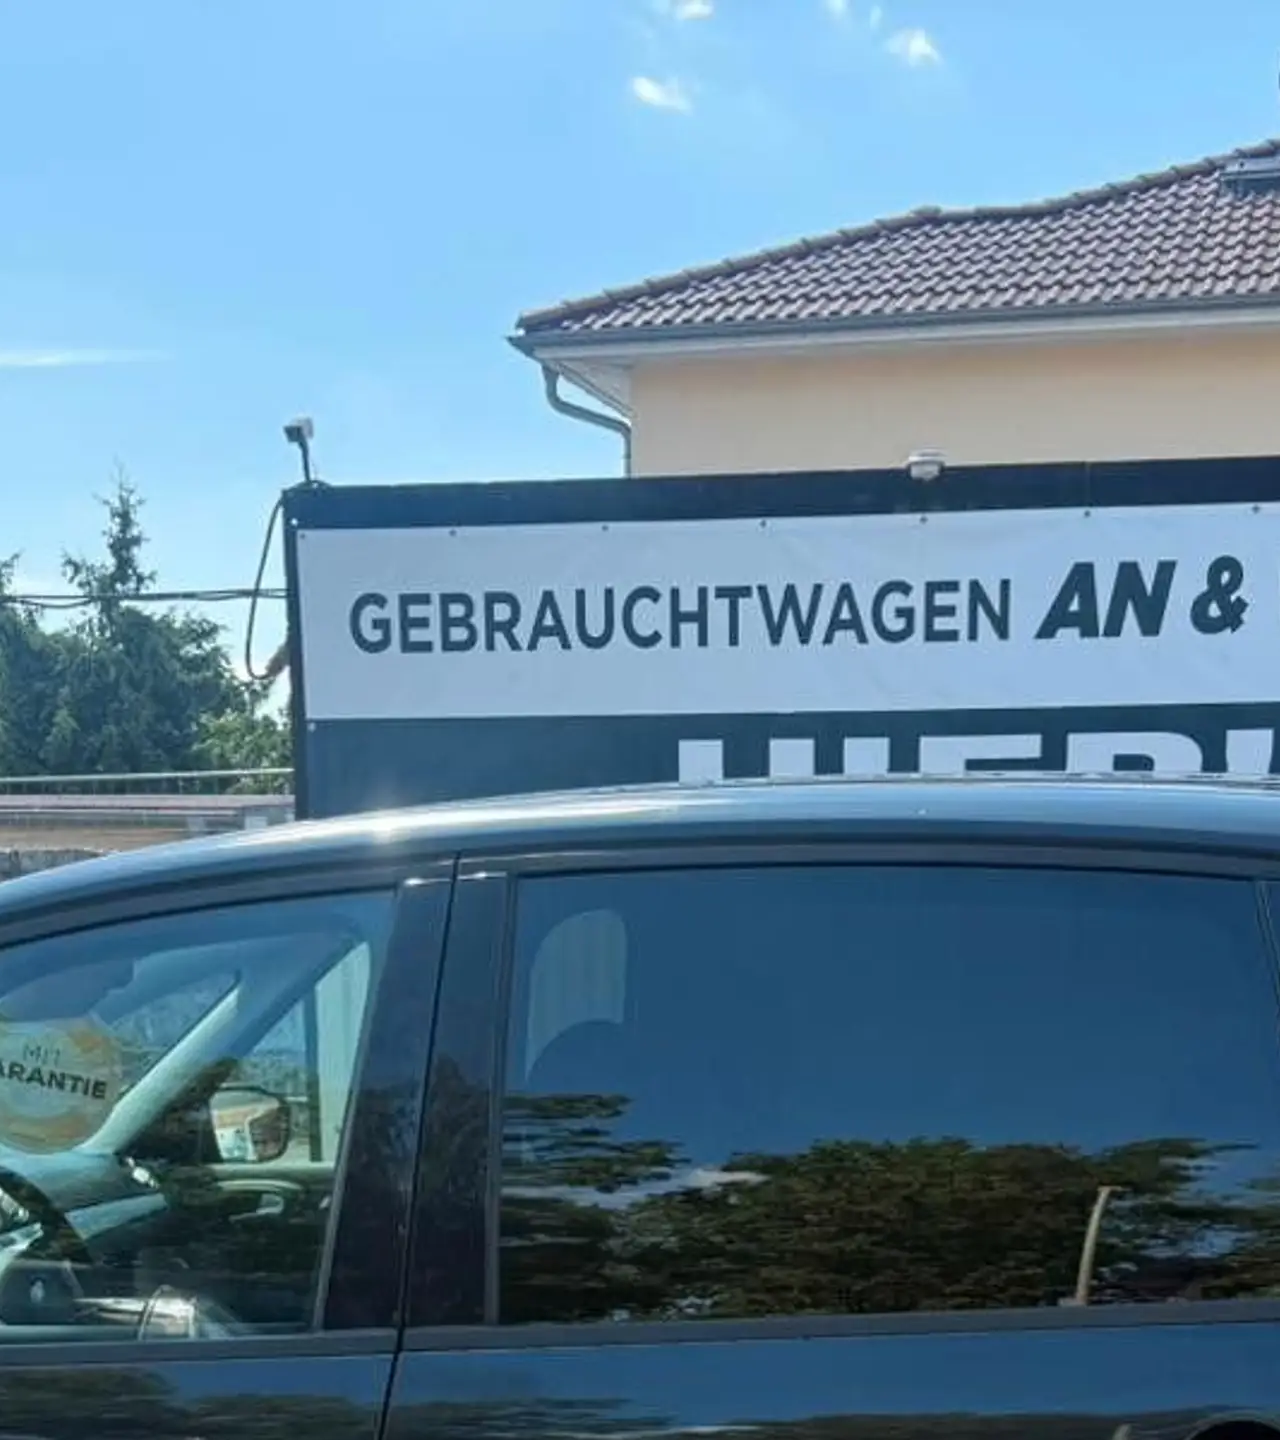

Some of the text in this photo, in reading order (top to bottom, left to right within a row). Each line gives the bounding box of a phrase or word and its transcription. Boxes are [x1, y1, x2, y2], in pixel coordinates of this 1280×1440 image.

[348, 578, 1011, 655] GEBRAUCHTWAGEN
[1033, 559, 1178, 640] AN
[1189, 554, 1250, 635] &
